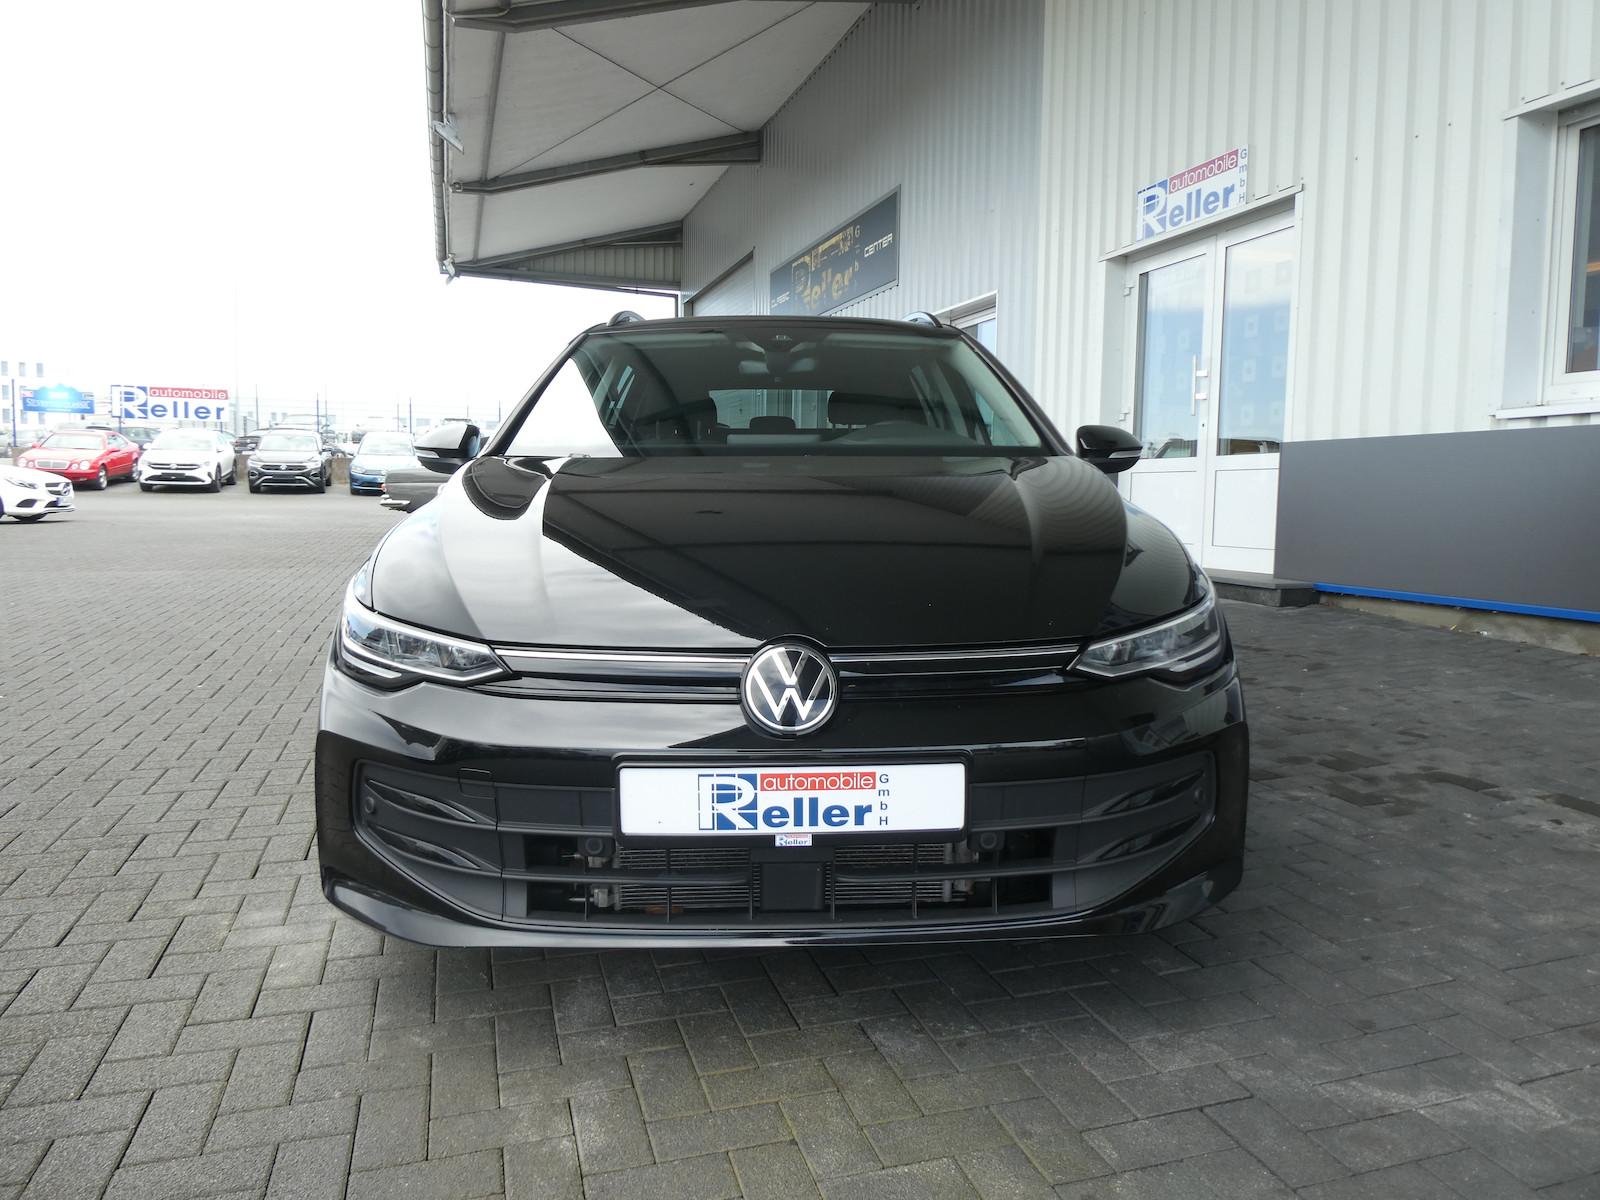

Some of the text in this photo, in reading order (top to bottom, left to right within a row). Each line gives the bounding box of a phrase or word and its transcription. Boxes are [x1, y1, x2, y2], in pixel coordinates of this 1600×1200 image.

[1170, 153, 1237, 193] automobile
[1137, 179, 1235, 240] Reller
[864, 233, 893, 258] CENTER
[112, 385, 224, 419] Reller
[150, 388, 227, 400] automobile
[746, 646, 833, 730] VW
[763, 773, 874, 791] automobile
[698, 774, 872, 830] Reller
